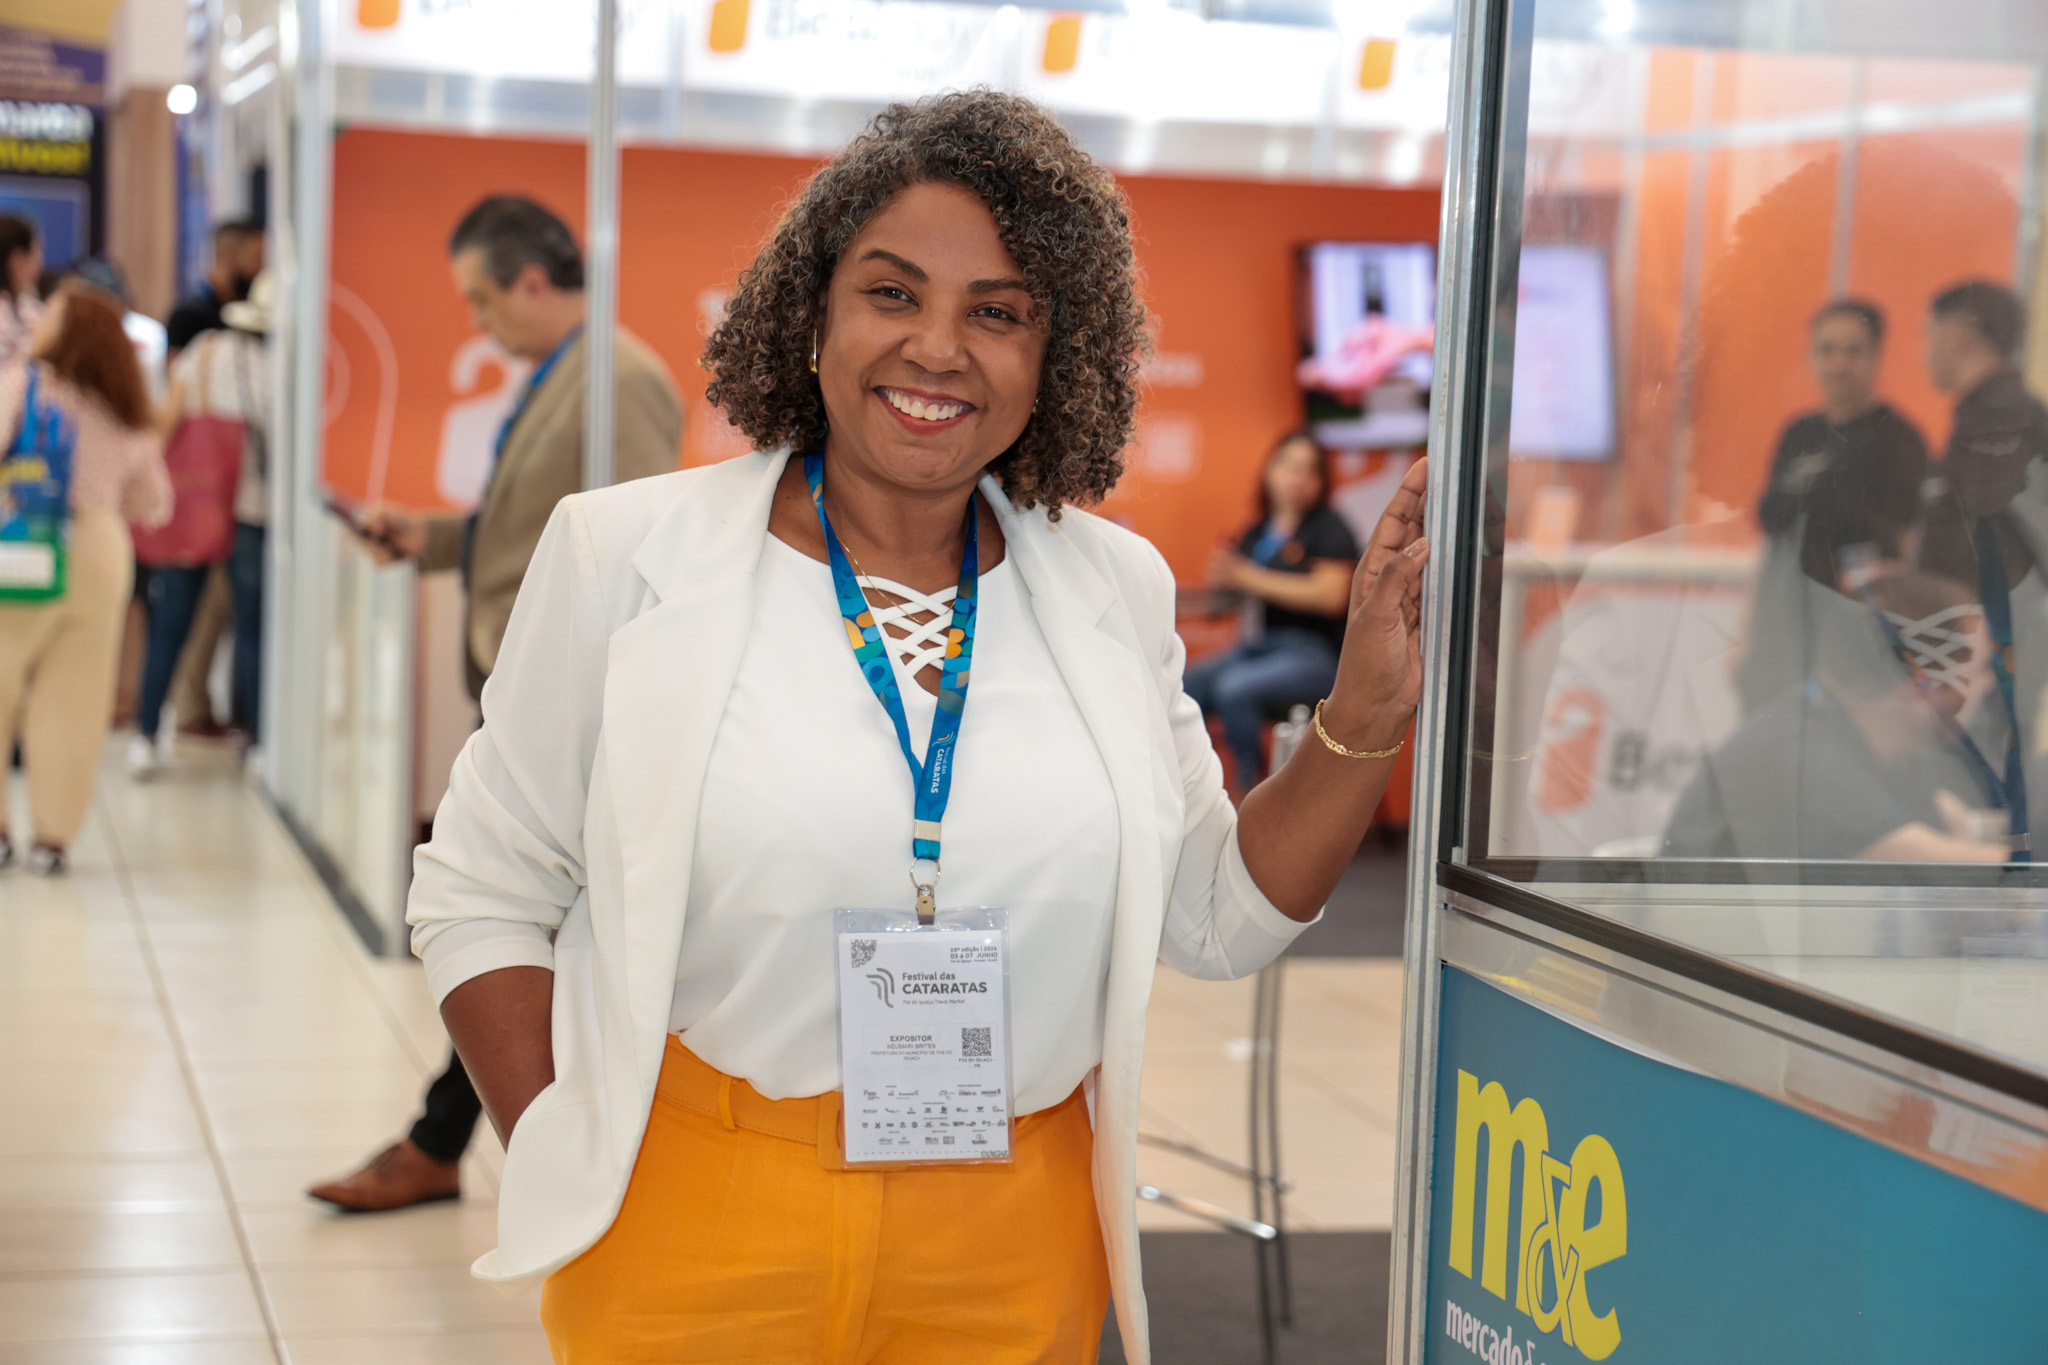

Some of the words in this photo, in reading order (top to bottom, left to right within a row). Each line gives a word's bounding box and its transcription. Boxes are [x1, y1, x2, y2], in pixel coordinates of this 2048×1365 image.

[930, 748, 945, 794] CATARATAS
[902, 971, 938, 981] Festival
[939, 971, 956, 980] das
[902, 982, 988, 995] CATARATAS
[1449, 1068, 1627, 1361] m&e
[1446, 1299, 1523, 1365] mercado
